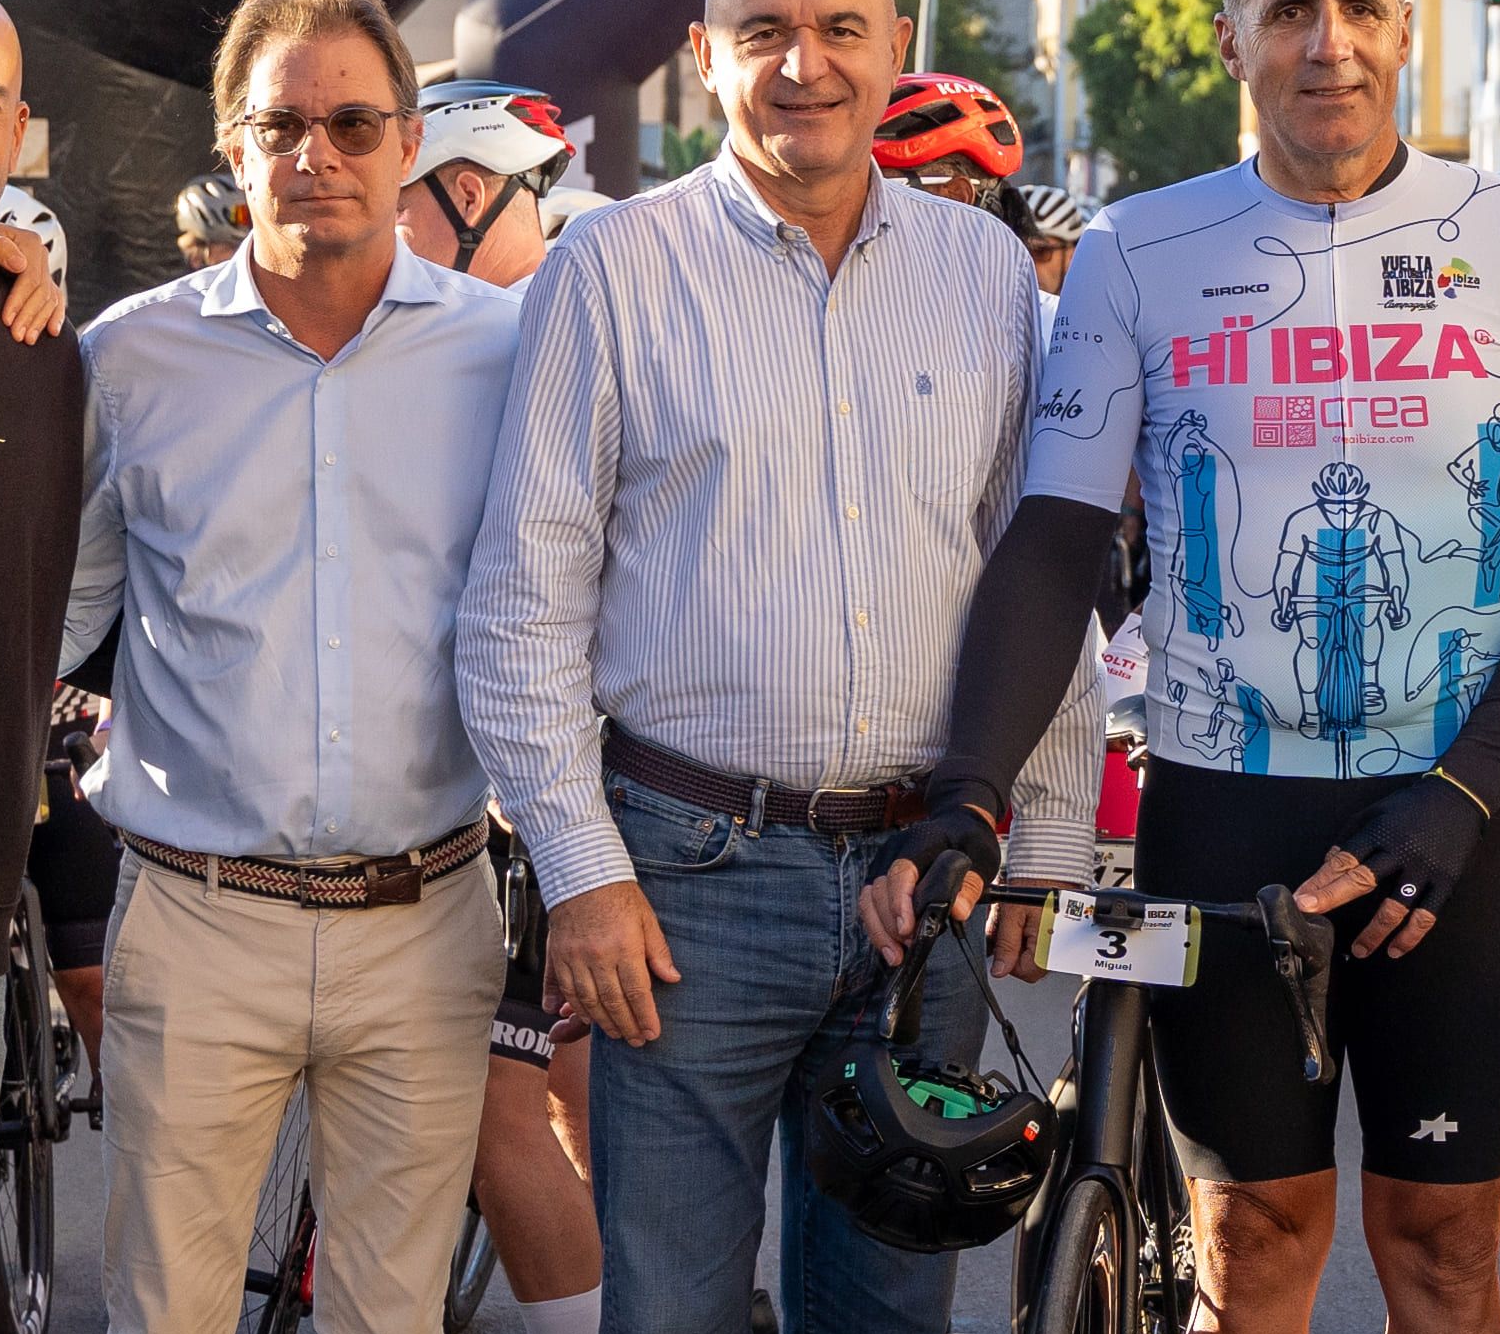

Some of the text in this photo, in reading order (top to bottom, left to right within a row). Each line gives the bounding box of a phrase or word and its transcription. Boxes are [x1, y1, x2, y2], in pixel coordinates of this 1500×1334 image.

[1380, 255, 1433, 272] VUELTA
[1201, 282, 1270, 298] SIROKO
[1383, 279, 1436, 298] A IBIZA
[1171, 314, 1254, 388] HÏ
[1320, 395, 1430, 429] crea
[1096, 930, 1128, 959] 3
[1094, 959, 1132, 971] Miguel
